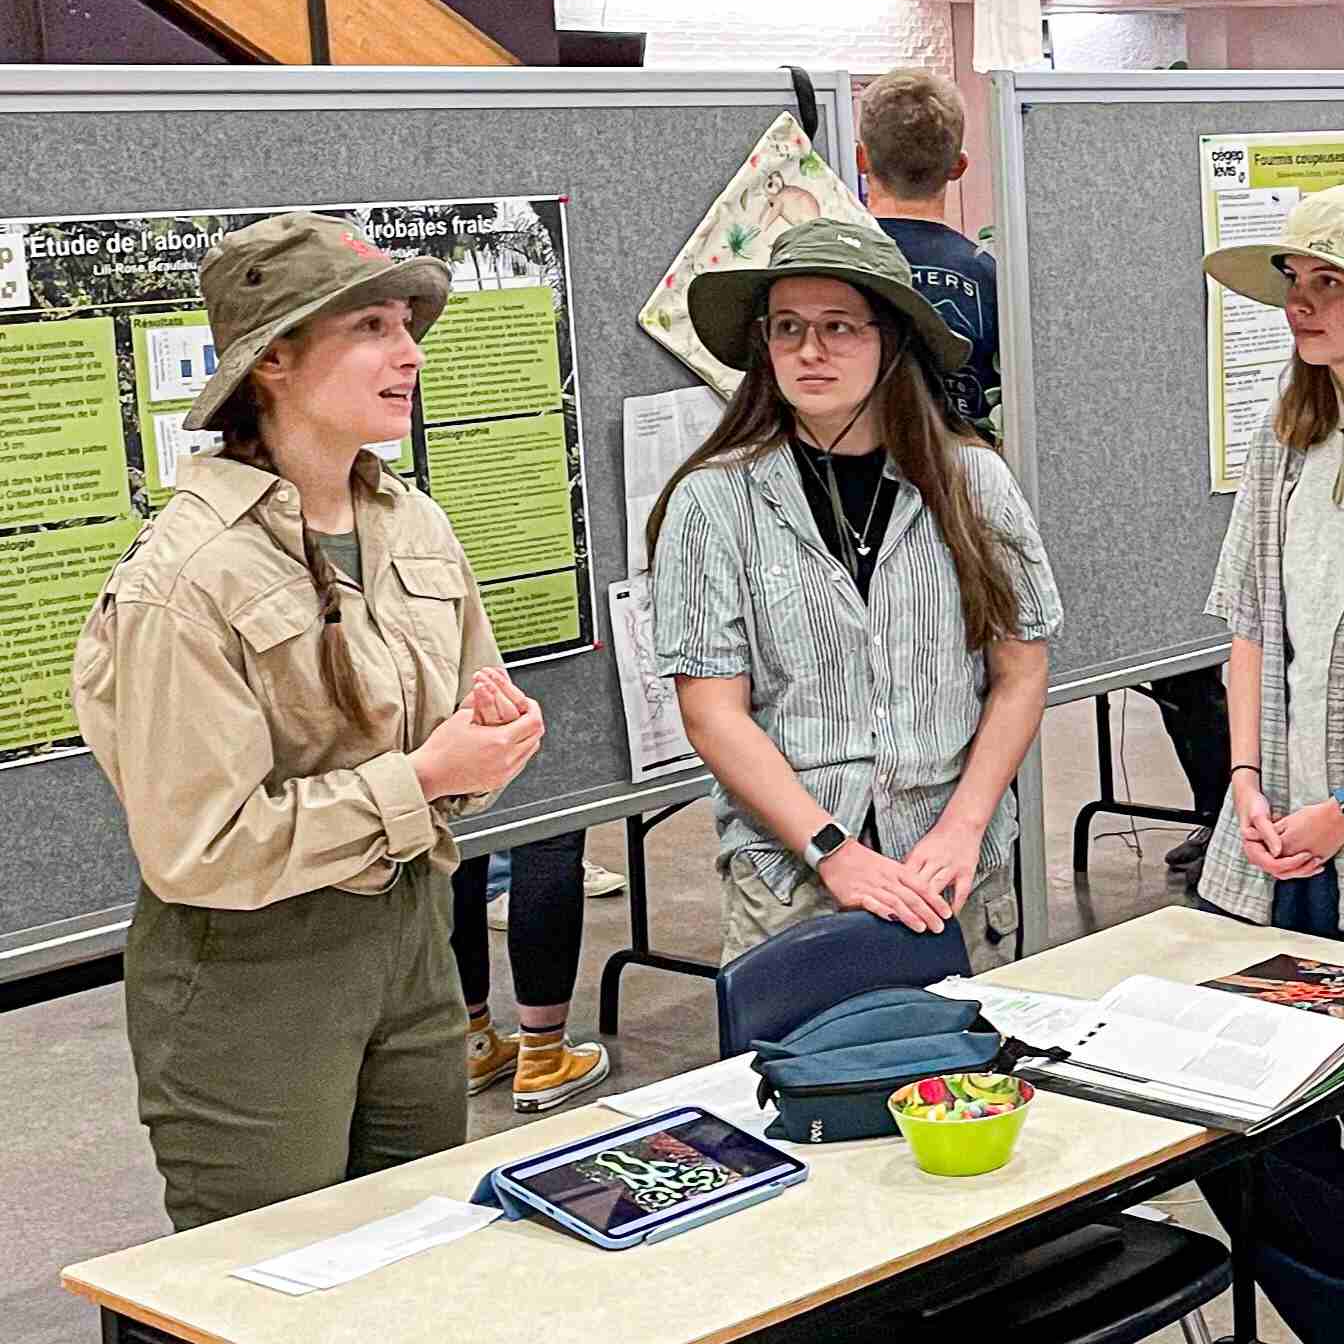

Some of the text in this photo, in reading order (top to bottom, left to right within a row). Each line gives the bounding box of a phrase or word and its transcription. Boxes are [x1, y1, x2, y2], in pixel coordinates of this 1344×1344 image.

[365, 213, 494, 239] drobates frais
[106, 233, 134, 254] de
[141, 227, 224, 252] l'abond
[911, 271, 974, 296] HERS
